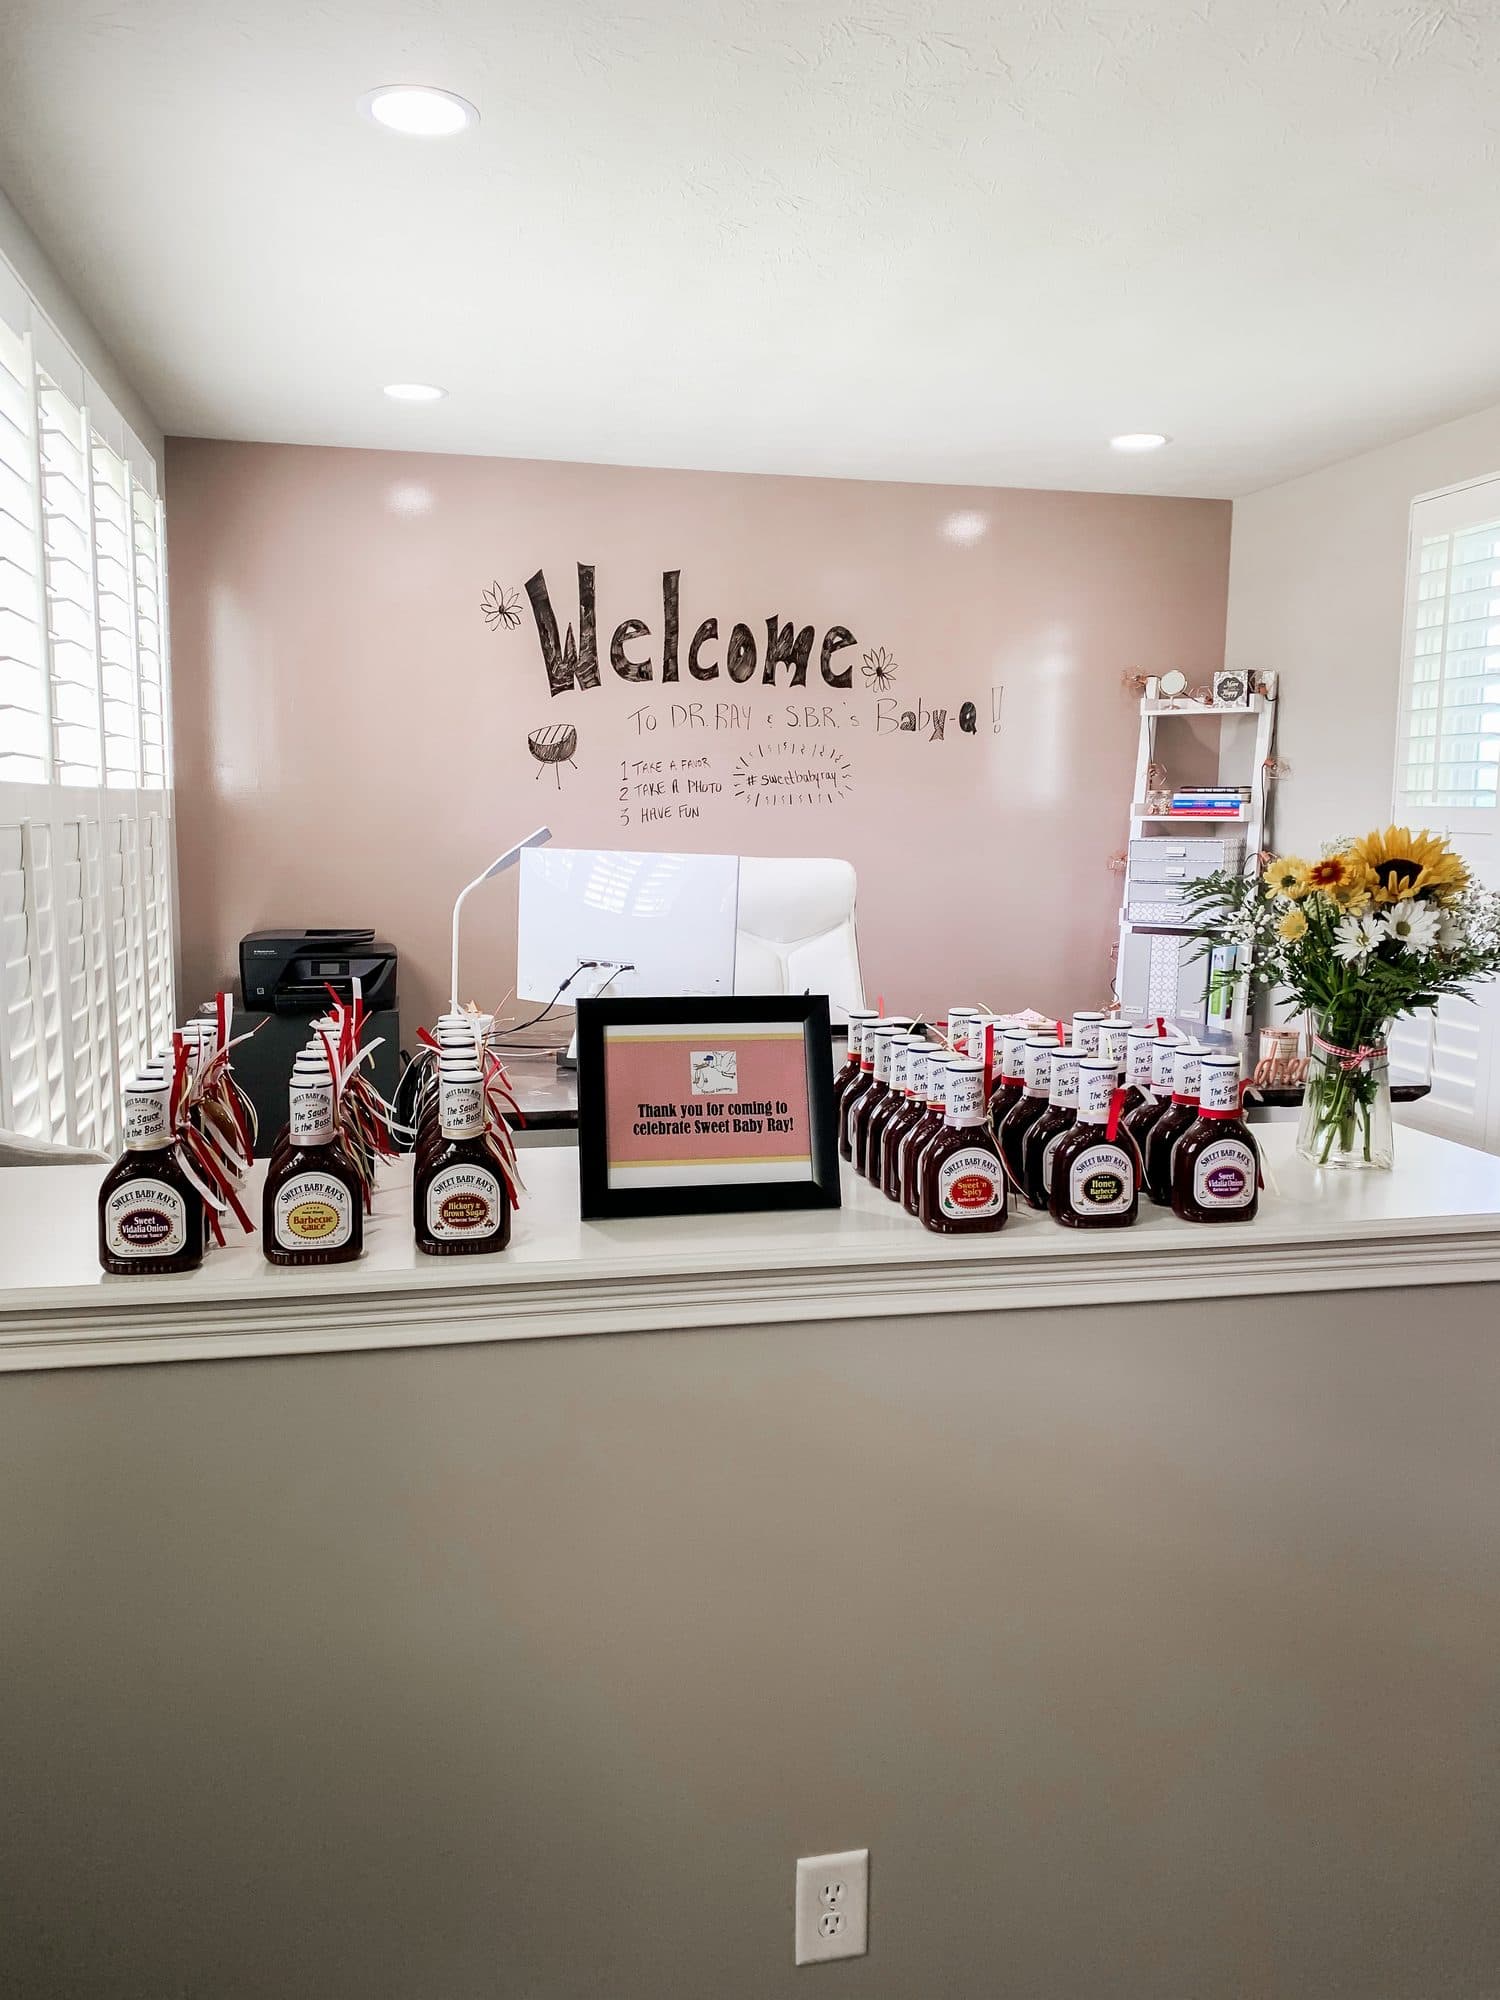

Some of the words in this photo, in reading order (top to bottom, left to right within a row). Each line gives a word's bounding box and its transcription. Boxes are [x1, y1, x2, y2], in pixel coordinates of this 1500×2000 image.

[525, 562, 857, 697] Welcome
[627, 705, 657, 735] TO
[671, 702, 709, 729] DR.
[716, 703, 751, 730] RAY
[632, 759, 662, 776] TAKE
[669, 759, 678, 770] A
[681, 757, 711, 770] FAVOR
[618, 786, 630, 801] 2
[634, 782, 665, 797] TAKE
[672, 779, 680, 794] A
[687, 779, 722, 794] PHOTO
[619, 807, 630, 826] 3
[641, 804, 672, 823] HAVE
[678, 803, 700, 819] FUN
[447, 1106, 458, 1115] The
[638, 1102, 677, 1118] Thank
[680, 1103, 702, 1119] you
[706, 1101, 724, 1117] for
[728, 1100, 773, 1117] coming
[776, 1100, 788, 1115] to
[136, 1111, 160, 1124] Sauce
[294, 1112, 306, 1121] The
[453, 1117, 464, 1126] the
[131, 1127, 142, 1138] the
[301, 1122, 313, 1132] the
[633, 1119, 691, 1136] celebrate
[694, 1119, 730, 1134] Sweet
[732, 1117, 763, 1133] Baby
[767, 1117, 794, 1133] Ray!
[1076, 1157, 1096, 1174] SWEET
[1096, 1154, 1113, 1163] BABY
[1200, 1150, 1220, 1168] SWEET
[1220, 1149, 1236, 1157] BABY
[943, 1159, 964, 1177] SWEET
[964, 1157, 981, 1166] BABY
[433, 1177, 455, 1195] SWEET
[456, 1175, 475, 1183] BABY
[957, 1181, 979, 1190] Sweet
[1091, 1180, 1116, 1189] Honey
[280, 1184, 303, 1204] SWEET
[304, 1182, 325, 1192] BABY
[962, 1188, 983, 1198] Spicy
[111, 1190, 134, 1211] SWEET
[135, 1189, 156, 1199] BABY
[448, 1201, 474, 1210] Hickory
[443, 1209, 464, 1217] Brown
[465, 1209, 486, 1218] Sugar
[134, 1215, 155, 1225] Sweet
[293, 1216, 334, 1225] Barbecue
[122, 1224, 146, 1234] Vidalia
[146, 1223, 169, 1233] Onion
[301, 1223, 326, 1233] Sauce
